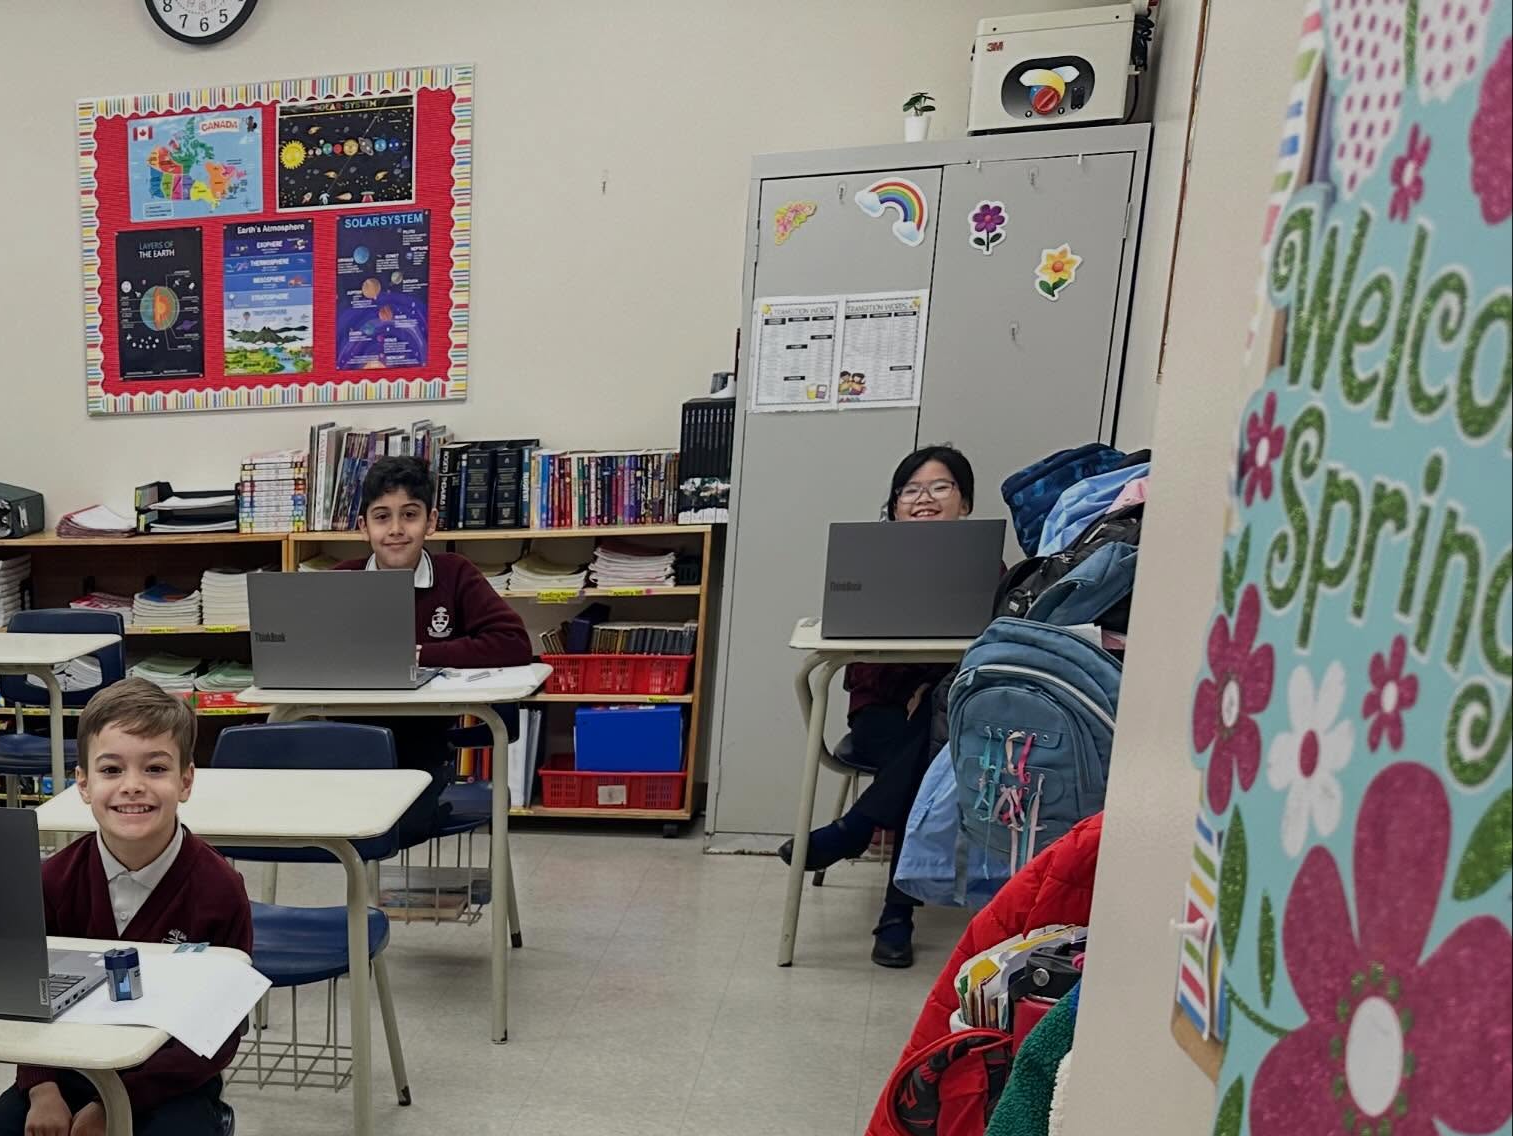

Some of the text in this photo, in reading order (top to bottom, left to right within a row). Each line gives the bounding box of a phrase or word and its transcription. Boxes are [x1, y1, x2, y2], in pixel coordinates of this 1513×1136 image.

[179, 14, 188, 29] 7
[219, 8, 228, 24] 5
[199, 17, 209, 32] 6
[986, 41, 1004, 52] 3M
[200, 120, 238, 132] CANADA
[344, 213, 423, 228] SOLAR SYSTEM
[237, 223, 305, 234] Earth's Atmosphere
[139, 241, 174, 250] LAYERS OF
[139, 249, 175, 259] THE EARTH
[1270, 205, 1513, 440] Welco
